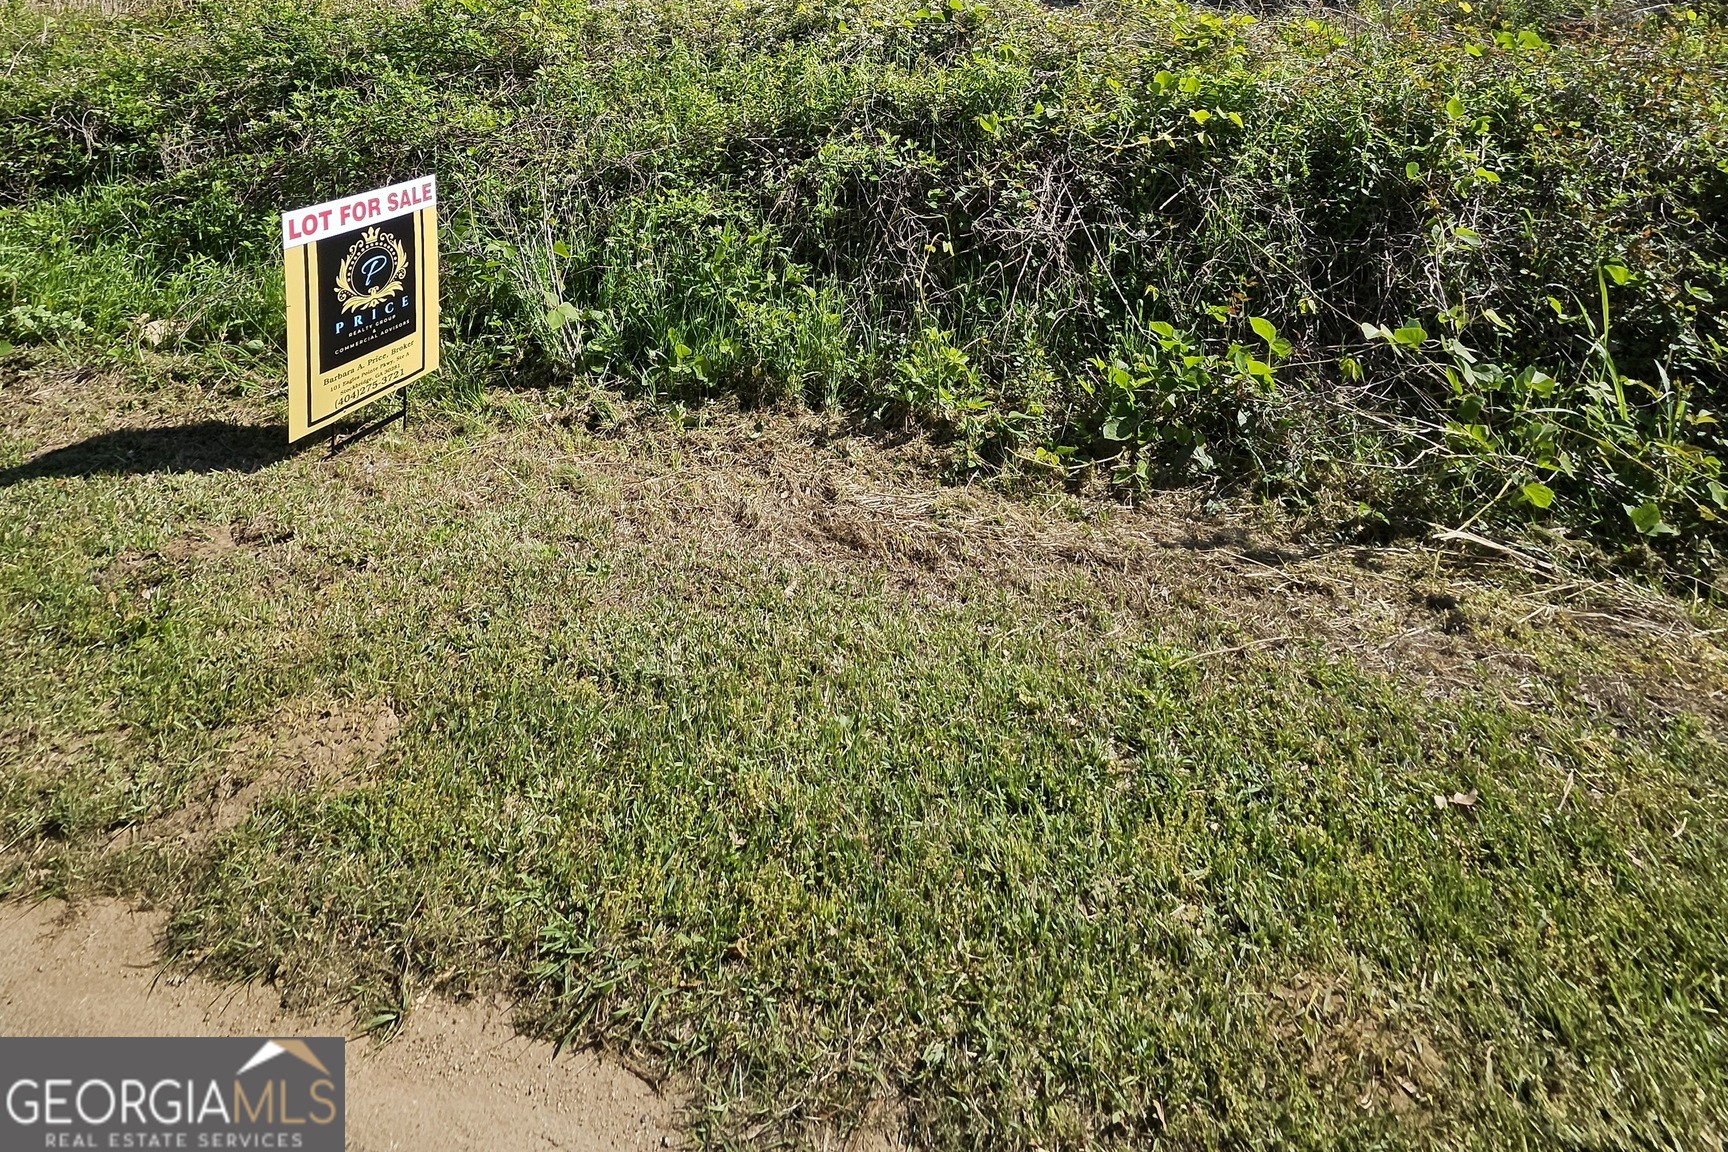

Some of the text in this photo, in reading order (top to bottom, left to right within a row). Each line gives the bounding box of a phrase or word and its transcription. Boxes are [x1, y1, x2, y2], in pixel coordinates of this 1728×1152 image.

[289, 183, 432, 240] LOT FOR SALE
[361, 255, 387, 286] P
[335, 296, 408, 334] PRICE
[348, 314, 396, 337] REALTY GROUP
[335, 319, 410, 355] COMMERCIAL ADVISORS
[323, 368, 354, 386] Barbara
[367, 353, 388, 366] Price,
[391, 340, 414, 355] Broker
[343, 376, 359, 387] Eagles
[361, 367, 378, 378] Pointe
[385, 364, 400, 374] 30281
[335, 368, 404, 409] (404)275-3721
